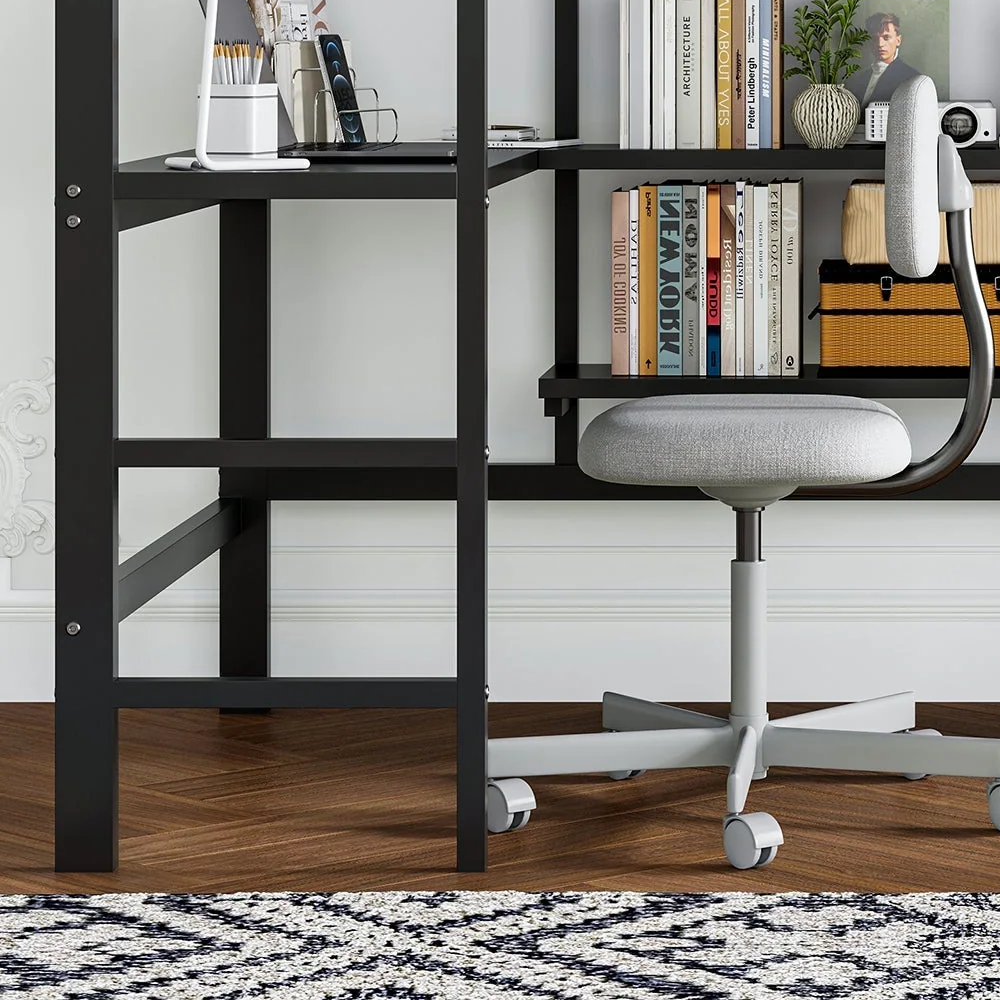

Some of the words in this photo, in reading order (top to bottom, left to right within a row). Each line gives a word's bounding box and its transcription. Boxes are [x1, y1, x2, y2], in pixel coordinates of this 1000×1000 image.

[683, 16, 691, 96] ARCHITECTURE
[718, 29, 729, 82] ABOUT
[747, 57, 757, 103] Lindbergh
[718, 88, 729, 126] YVES
[747, 105, 755, 129] Peter
